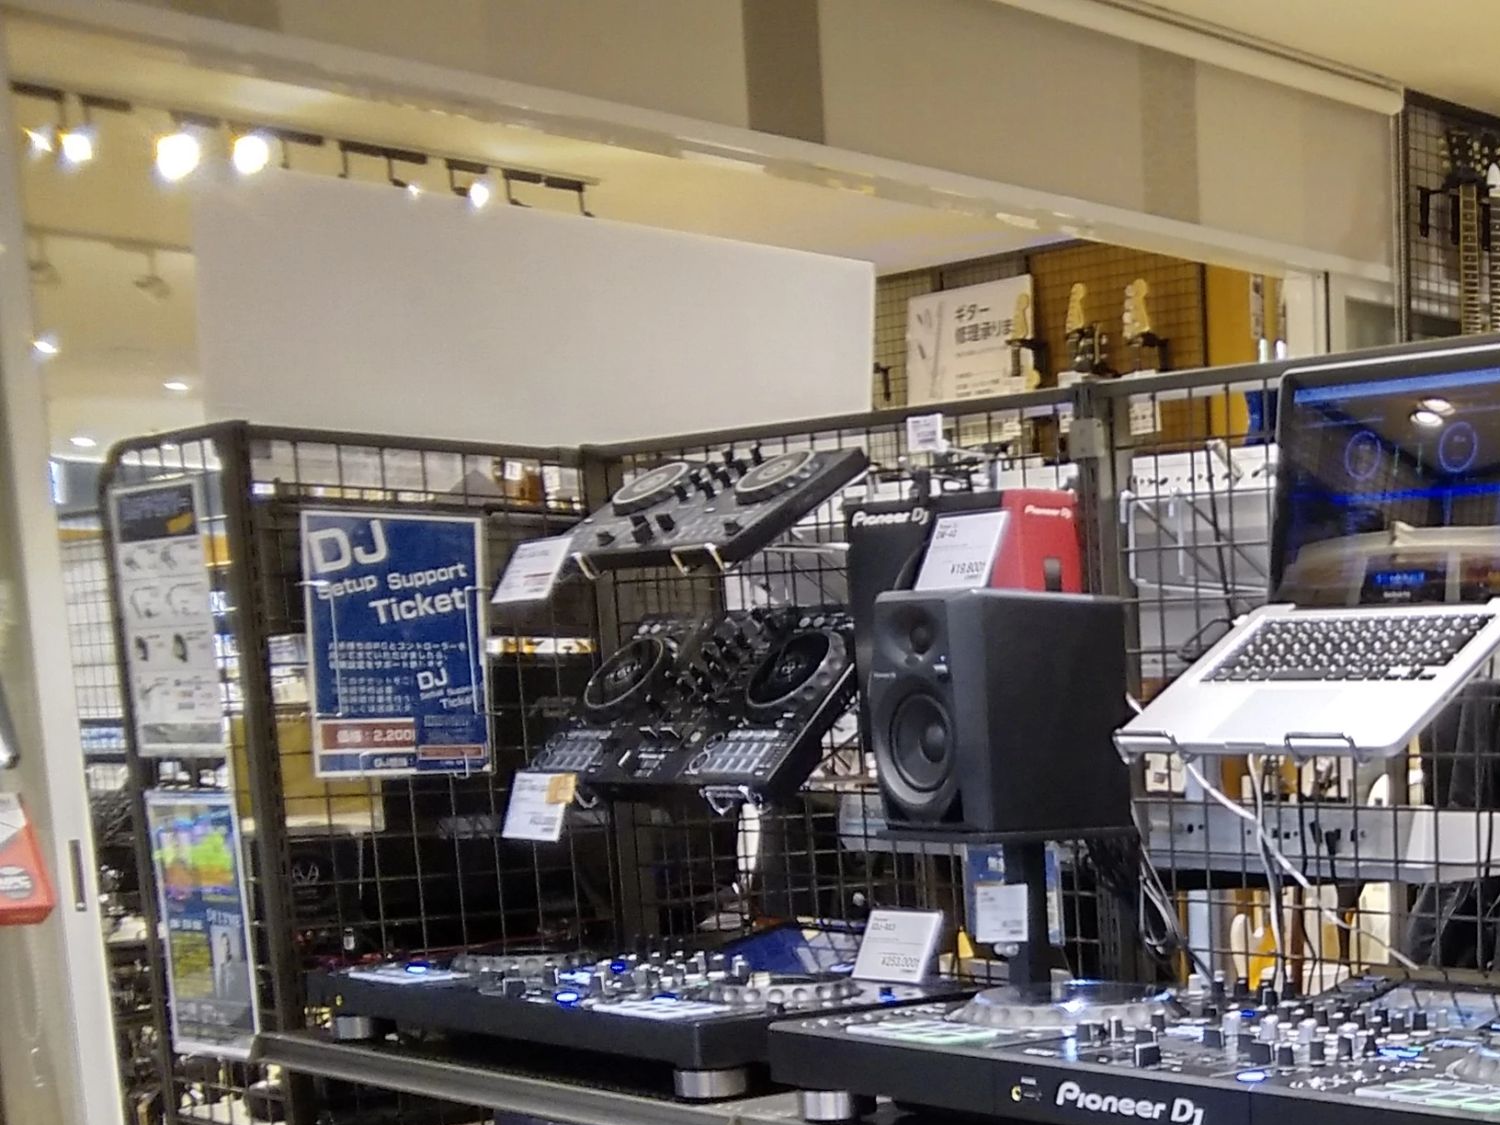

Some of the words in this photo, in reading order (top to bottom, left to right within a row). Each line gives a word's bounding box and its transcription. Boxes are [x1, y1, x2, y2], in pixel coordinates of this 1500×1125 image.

[852, 510, 910, 527] Pioneer
[1024, 504, 1060, 517] Pioneer
[308, 519, 388, 573] DJ
[316, 573, 377, 600] Setup
[387, 561, 468, 591] Support
[369, 587, 467, 625] Ticket
[416, 668, 448, 690] DJ
[1055, 1080, 1166, 1122] Pioneer
